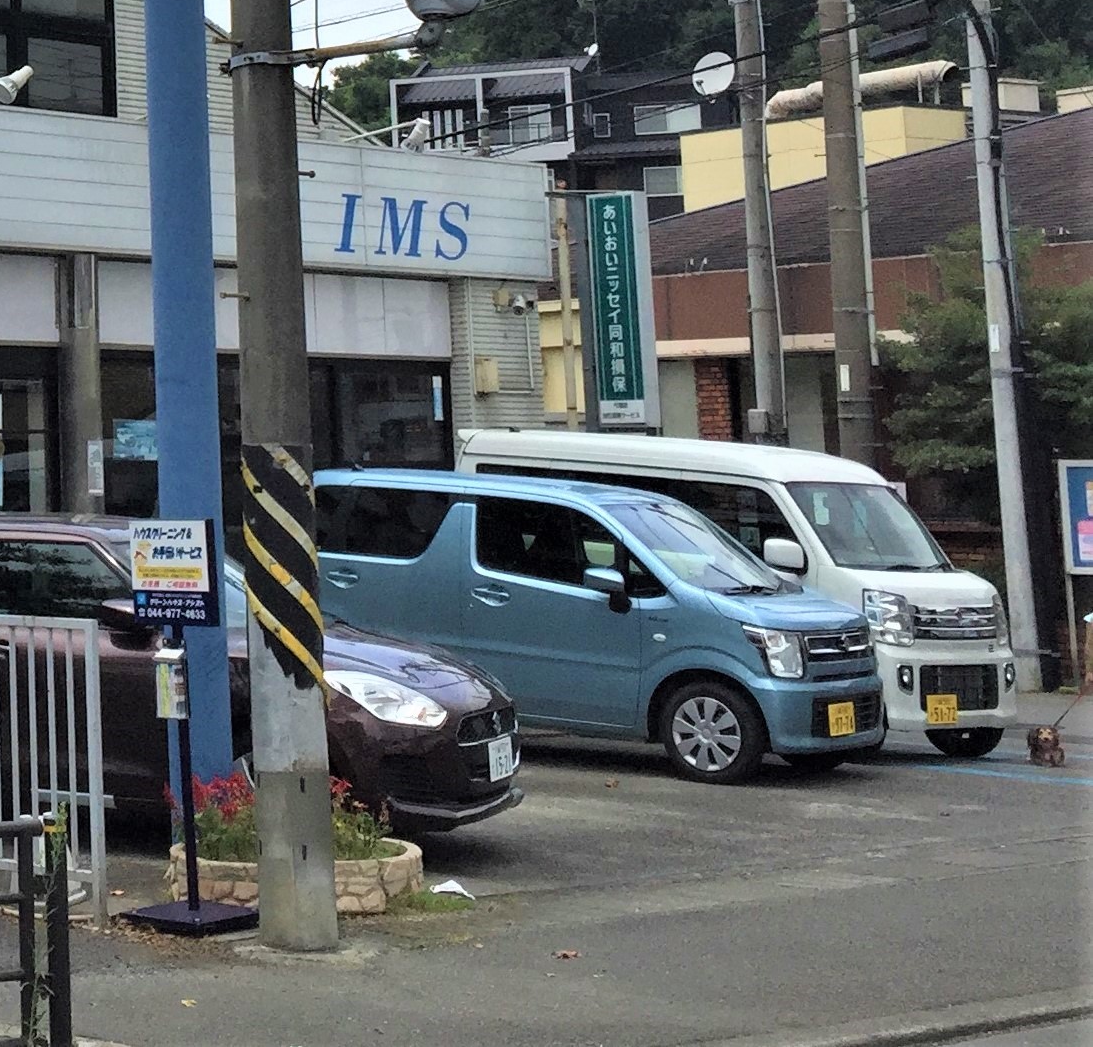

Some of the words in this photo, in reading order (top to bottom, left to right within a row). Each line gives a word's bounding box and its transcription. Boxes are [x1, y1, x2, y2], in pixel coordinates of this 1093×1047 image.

[334, 193, 470, 261] IMS
[603, 205, 627, 393] あいおいニッセイ同和損保
